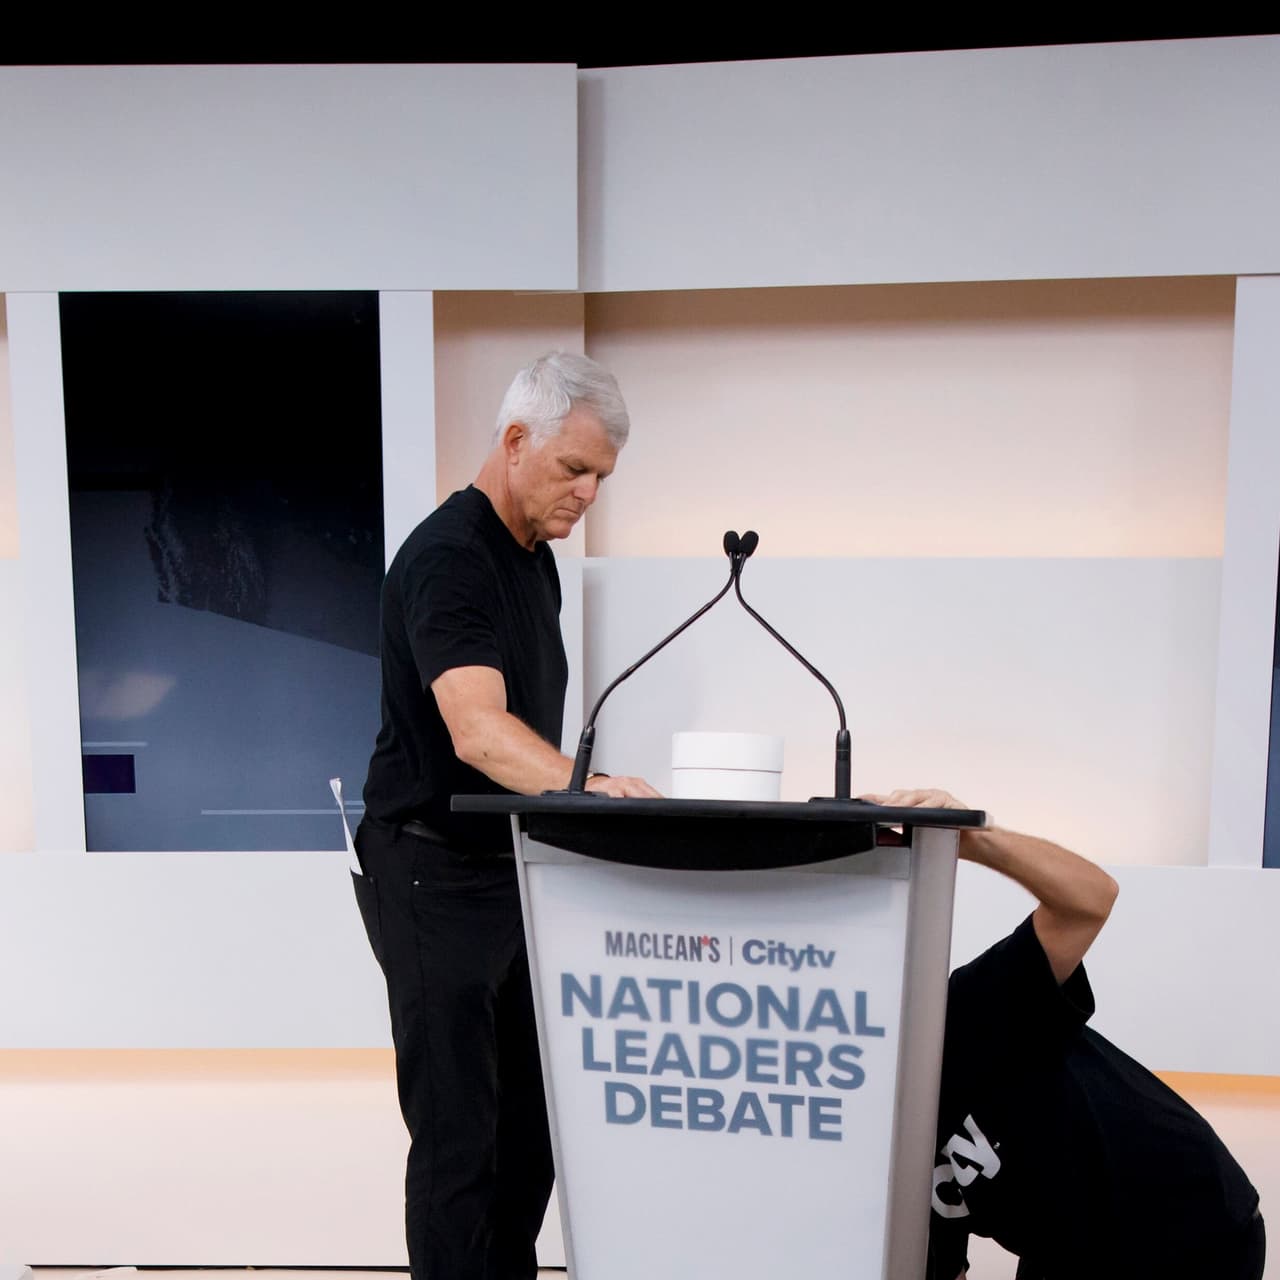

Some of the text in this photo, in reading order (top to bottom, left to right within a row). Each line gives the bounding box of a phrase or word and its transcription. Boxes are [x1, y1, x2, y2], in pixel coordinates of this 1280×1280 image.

[741, 939, 836, 972] Citytv
[560, 972, 886, 1038] NATIONAL
[582, 1027, 866, 1091] LEADERS
[604, 1081, 843, 1142] DEBATE
